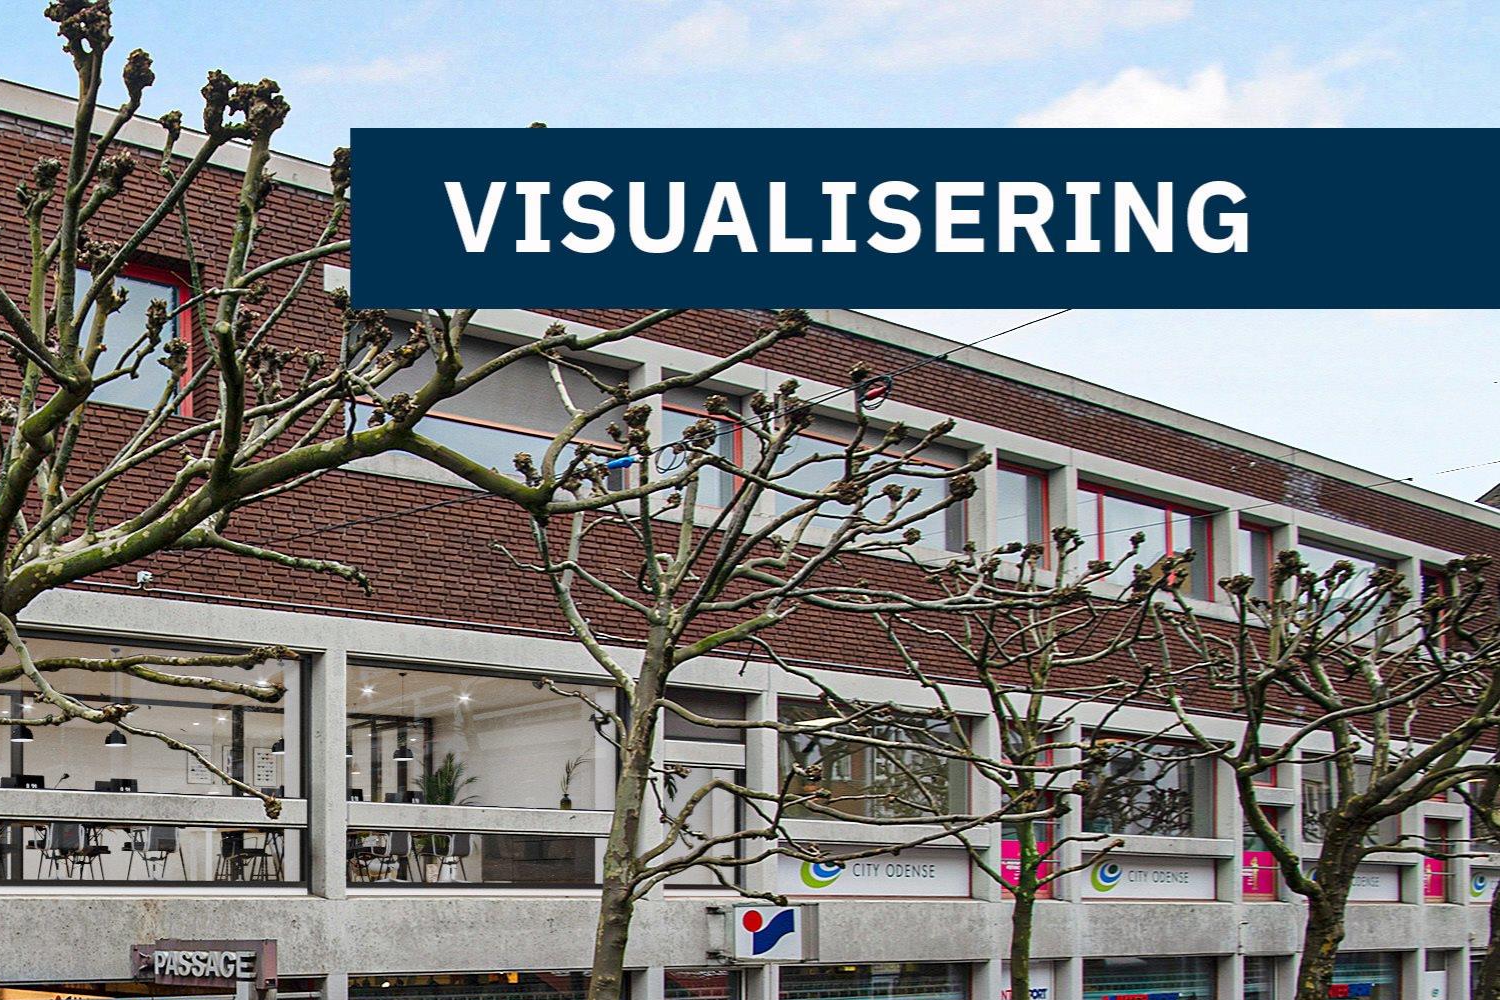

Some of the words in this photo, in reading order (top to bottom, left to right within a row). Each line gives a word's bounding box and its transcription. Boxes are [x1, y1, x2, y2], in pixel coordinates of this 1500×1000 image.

[853, 863, 881, 878] CITY
[886, 863, 936, 879] ODENSE
[1128, 870, 1148, 883] CITY
[1153, 870, 1190, 884] ODENSE
[153, 950, 257, 979] PASSAGE
